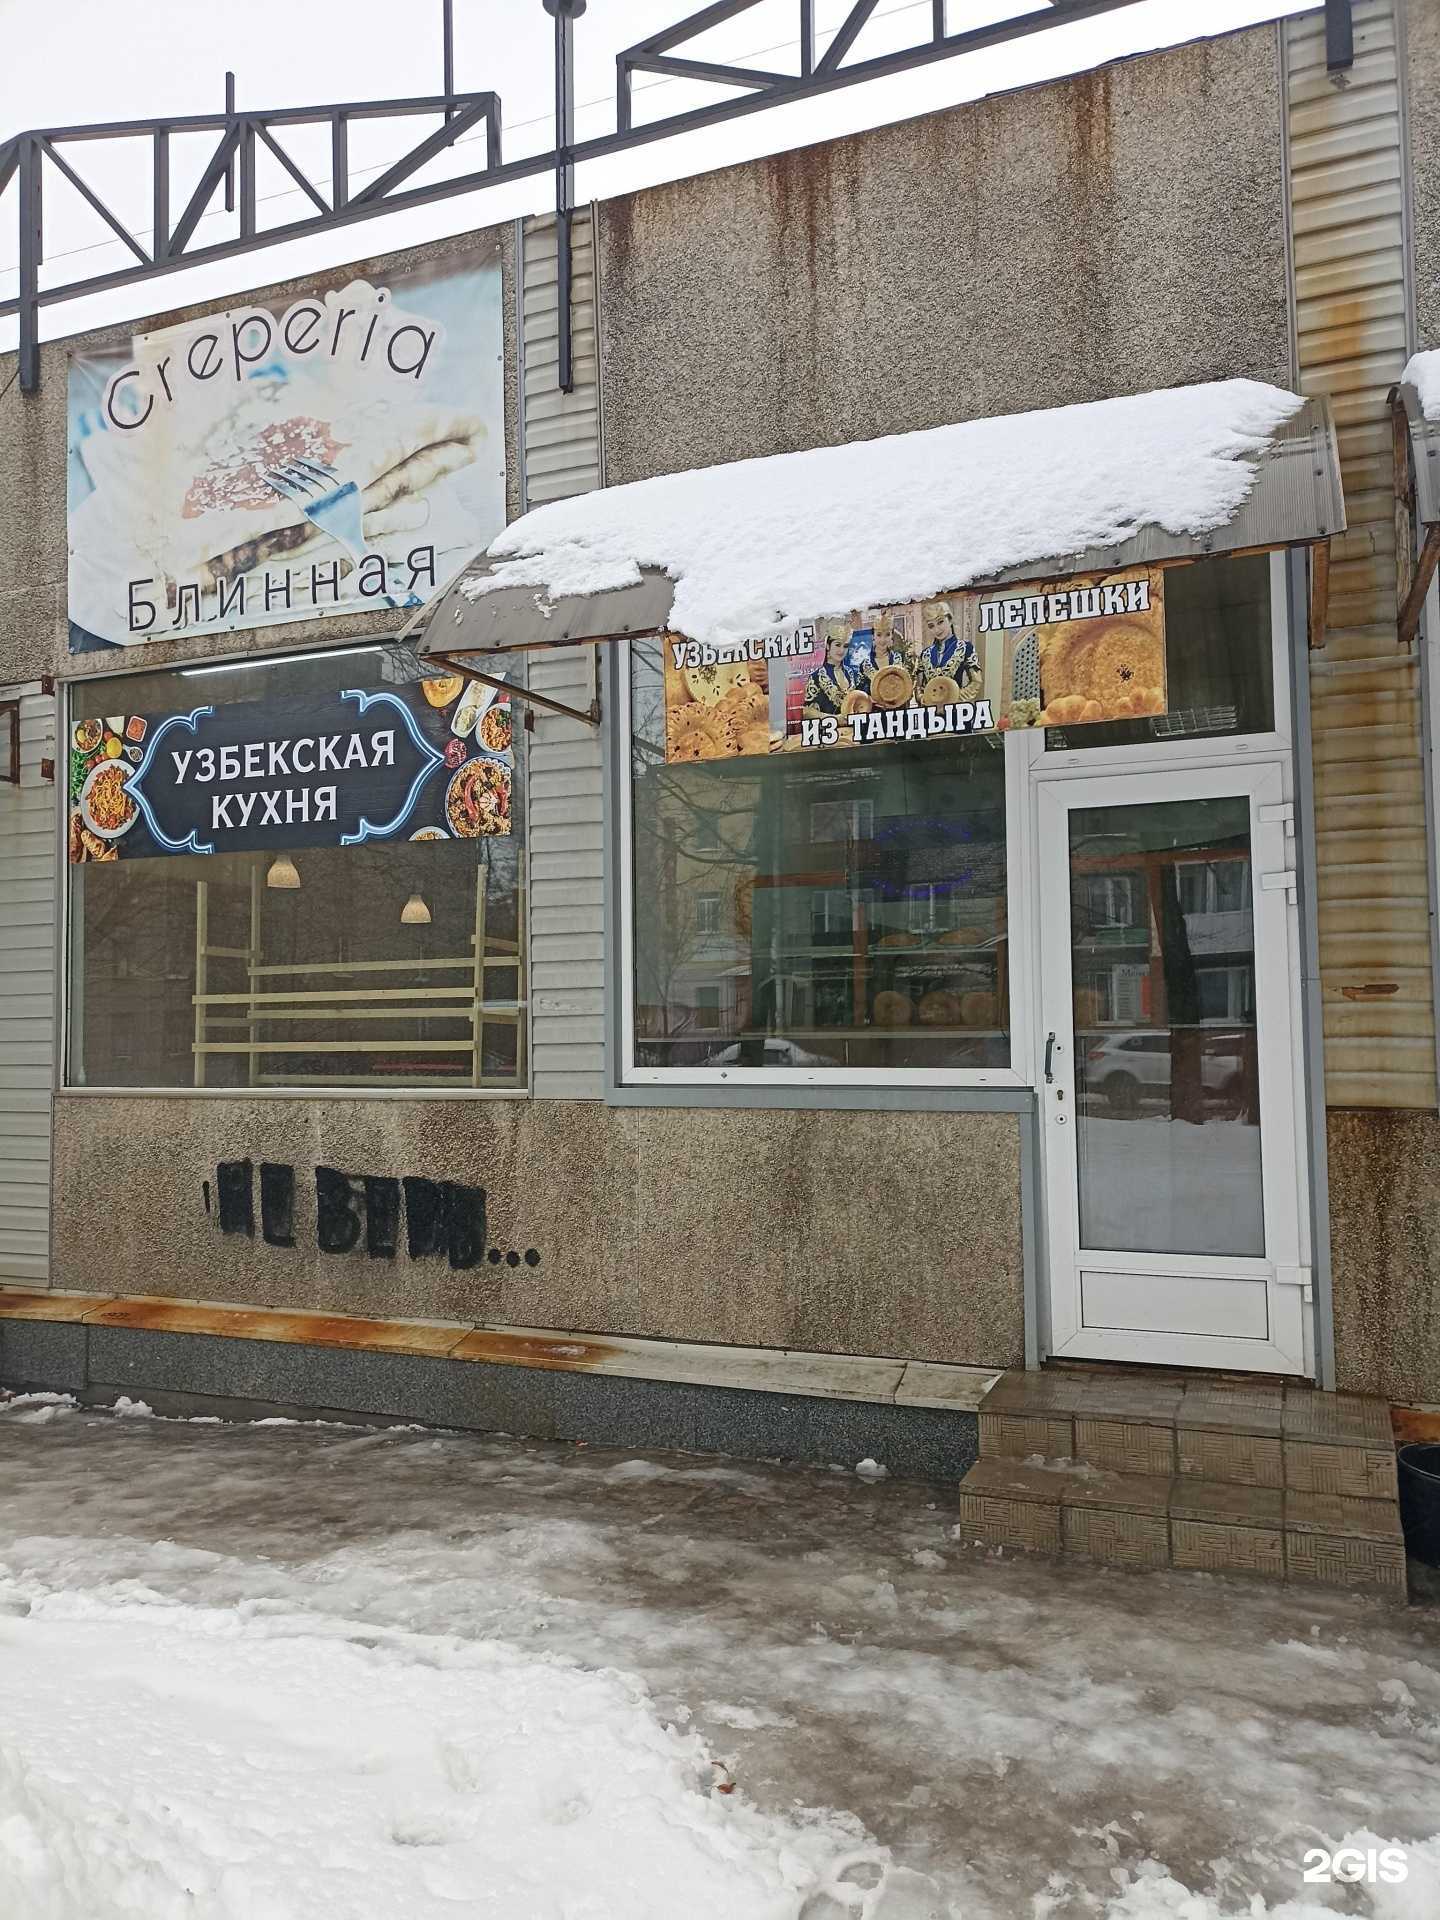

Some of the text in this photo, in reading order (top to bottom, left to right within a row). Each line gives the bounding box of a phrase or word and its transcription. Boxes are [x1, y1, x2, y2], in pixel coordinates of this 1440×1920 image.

[128, 545, 436, 632] Блинная
[979, 580, 1150, 632] ЛЕПЕШКИ
[801, 700, 994, 747] ИЗ ТАНДЫРА
[171, 729, 396, 785] УЗБЕКСКАЯ
[211, 785, 338, 829] КУХНЯ
